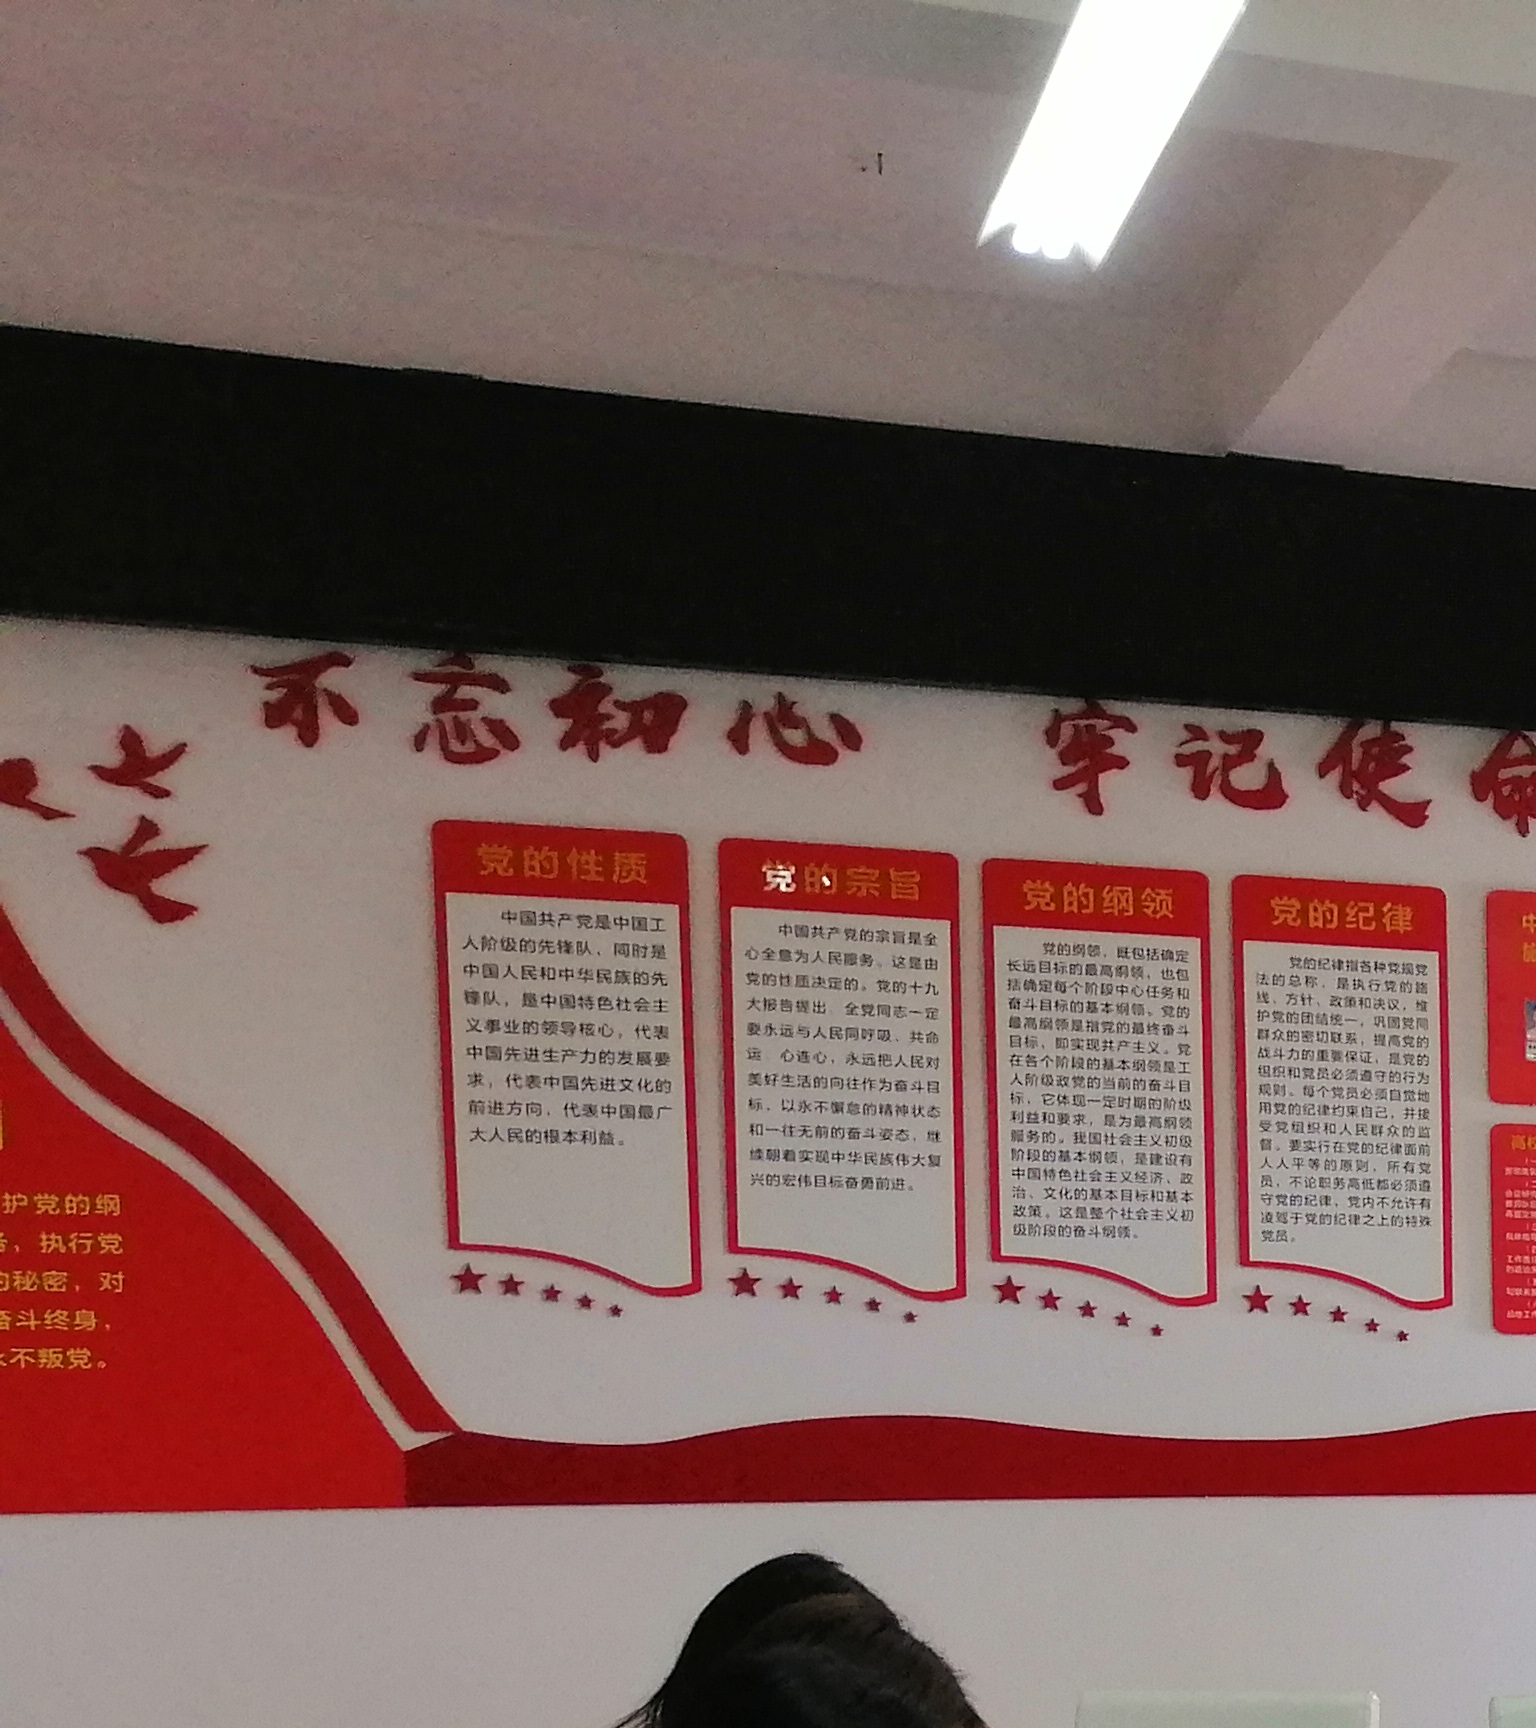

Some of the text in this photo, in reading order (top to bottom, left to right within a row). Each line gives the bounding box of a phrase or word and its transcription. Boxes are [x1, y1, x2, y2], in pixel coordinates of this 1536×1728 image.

[250, 651, 863, 766] 不忘初心
[477, 844, 648, 884] 党的性质
[762, 858, 920, 901] 党的宗旨
[1022, 880, 1174, 919] 党的纲领
[500, 910, 666, 932] 中国共产党是中国工
[1271, 897, 1414, 934] 党的纪律
[778, 924, 938, 947] 中国共产党的宗旨是全
[463, 963, 668, 987] 中国人民和中华民族的先
[1289, 956, 1428, 977] 党的纪律指各种党规党
[1008, 979, 1189, 1000] 括确定每个阶段中心任务和
[1009, 1017, 1190, 1037] 最高纲领是指党的最终奋斗
[467, 1045, 671, 1066] 中国先进生产力的发展要
[1010, 1055, 1191, 1074] 在各个阶段的基本纲领是工
[748, 1073, 940, 1094] 美好生活的向往作为奋斗目
[1010, 1073, 1191, 1093] 人阶级政党的当前的奋斗目
[1258, 1066, 1430, 1085] 组织和党员必须遵守的行为
[1259, 1121, 1430, 1139] 受党组织和人民群众的监
[2, 1192, 121, 1216] 护党的纲
[1261, 1212, 1432, 1228] 凌驾于党的纪律之上的特殊
[0, 1231, 124, 1254] ，执行党
[0, 1348, 107, 1370] 不叛党。
